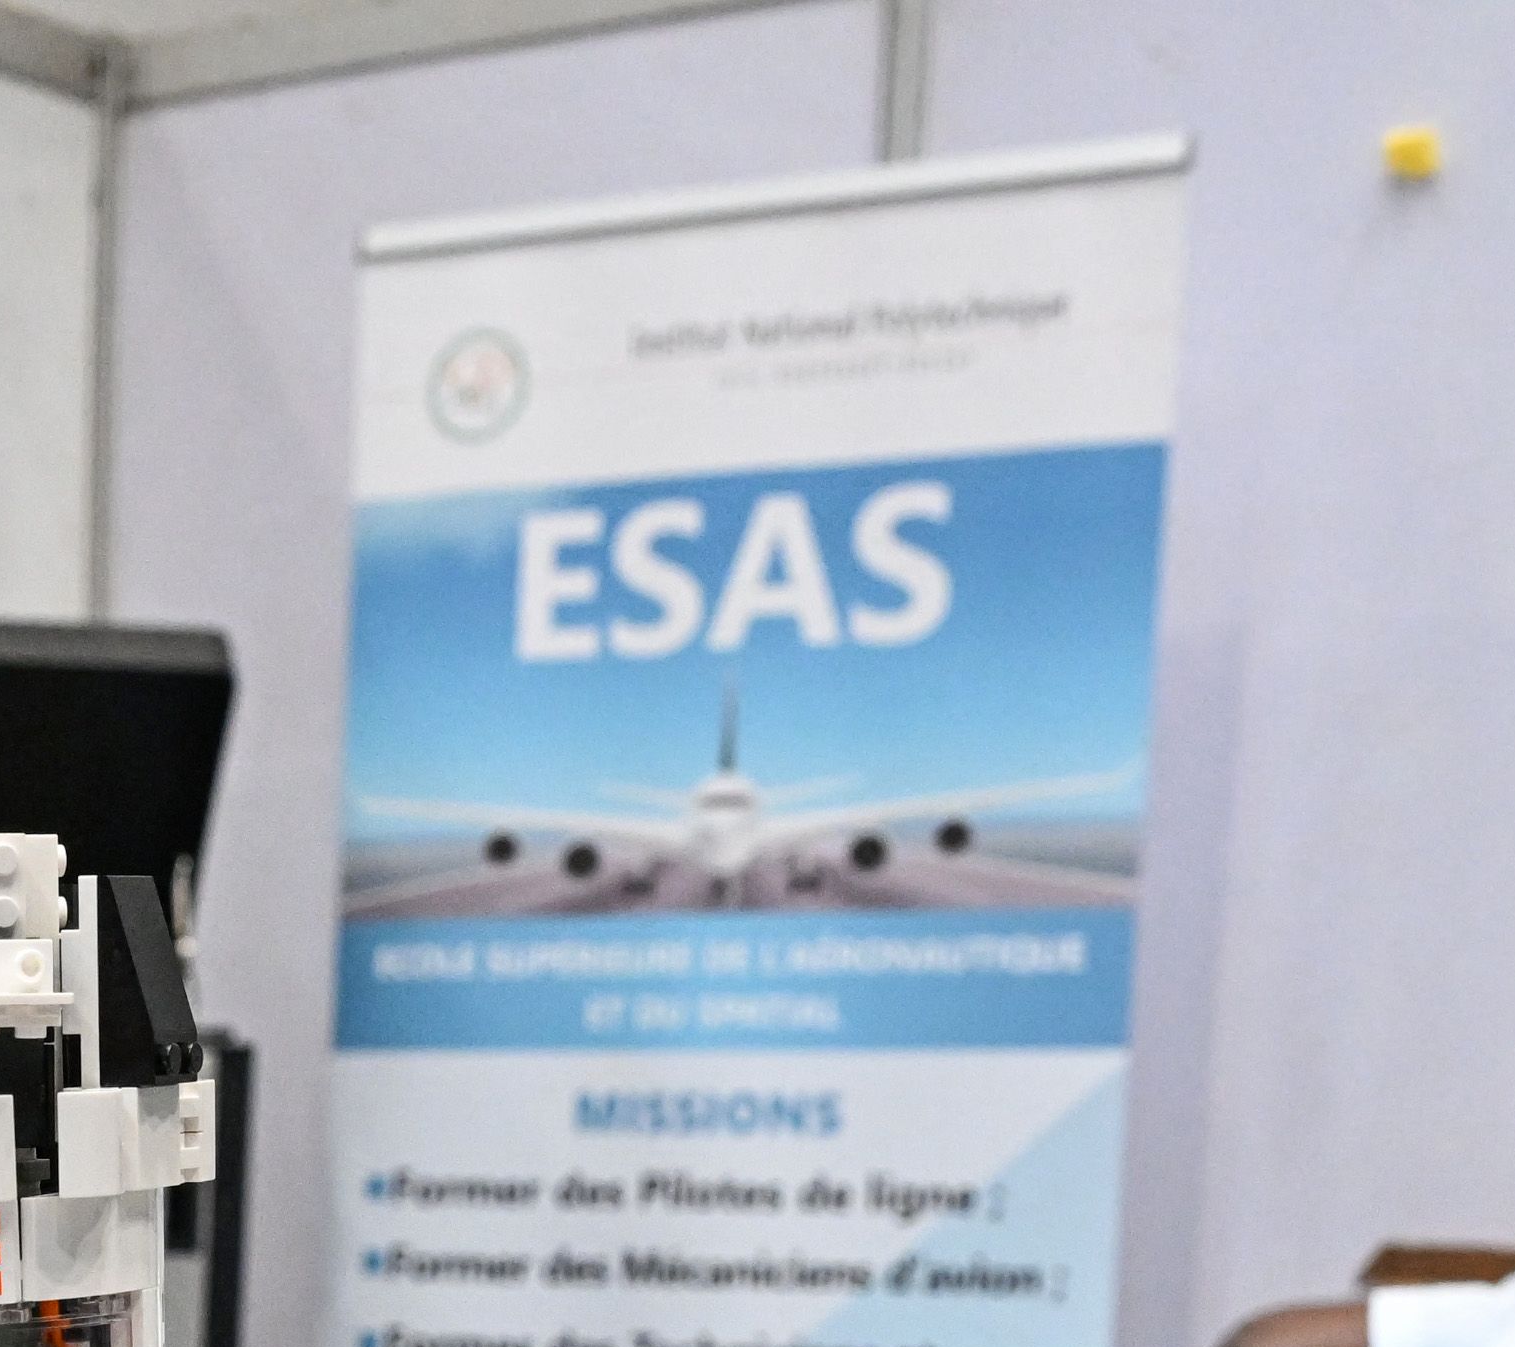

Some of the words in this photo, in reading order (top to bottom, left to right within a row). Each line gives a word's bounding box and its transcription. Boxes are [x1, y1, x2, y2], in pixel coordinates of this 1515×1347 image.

[516, 480, 955, 662] ESAS
[571, 1089, 843, 1139] MISSIONS
[387, 1170, 538, 1209] Former
[555, 1174, 622, 1210] des
[639, 1173, 780, 1211] Pilotes
[797, 1173, 849, 1211] de
[868, 1172, 977, 1226] ligne
[386, 1246, 529, 1282] Former
[545, 1249, 608, 1286] des
